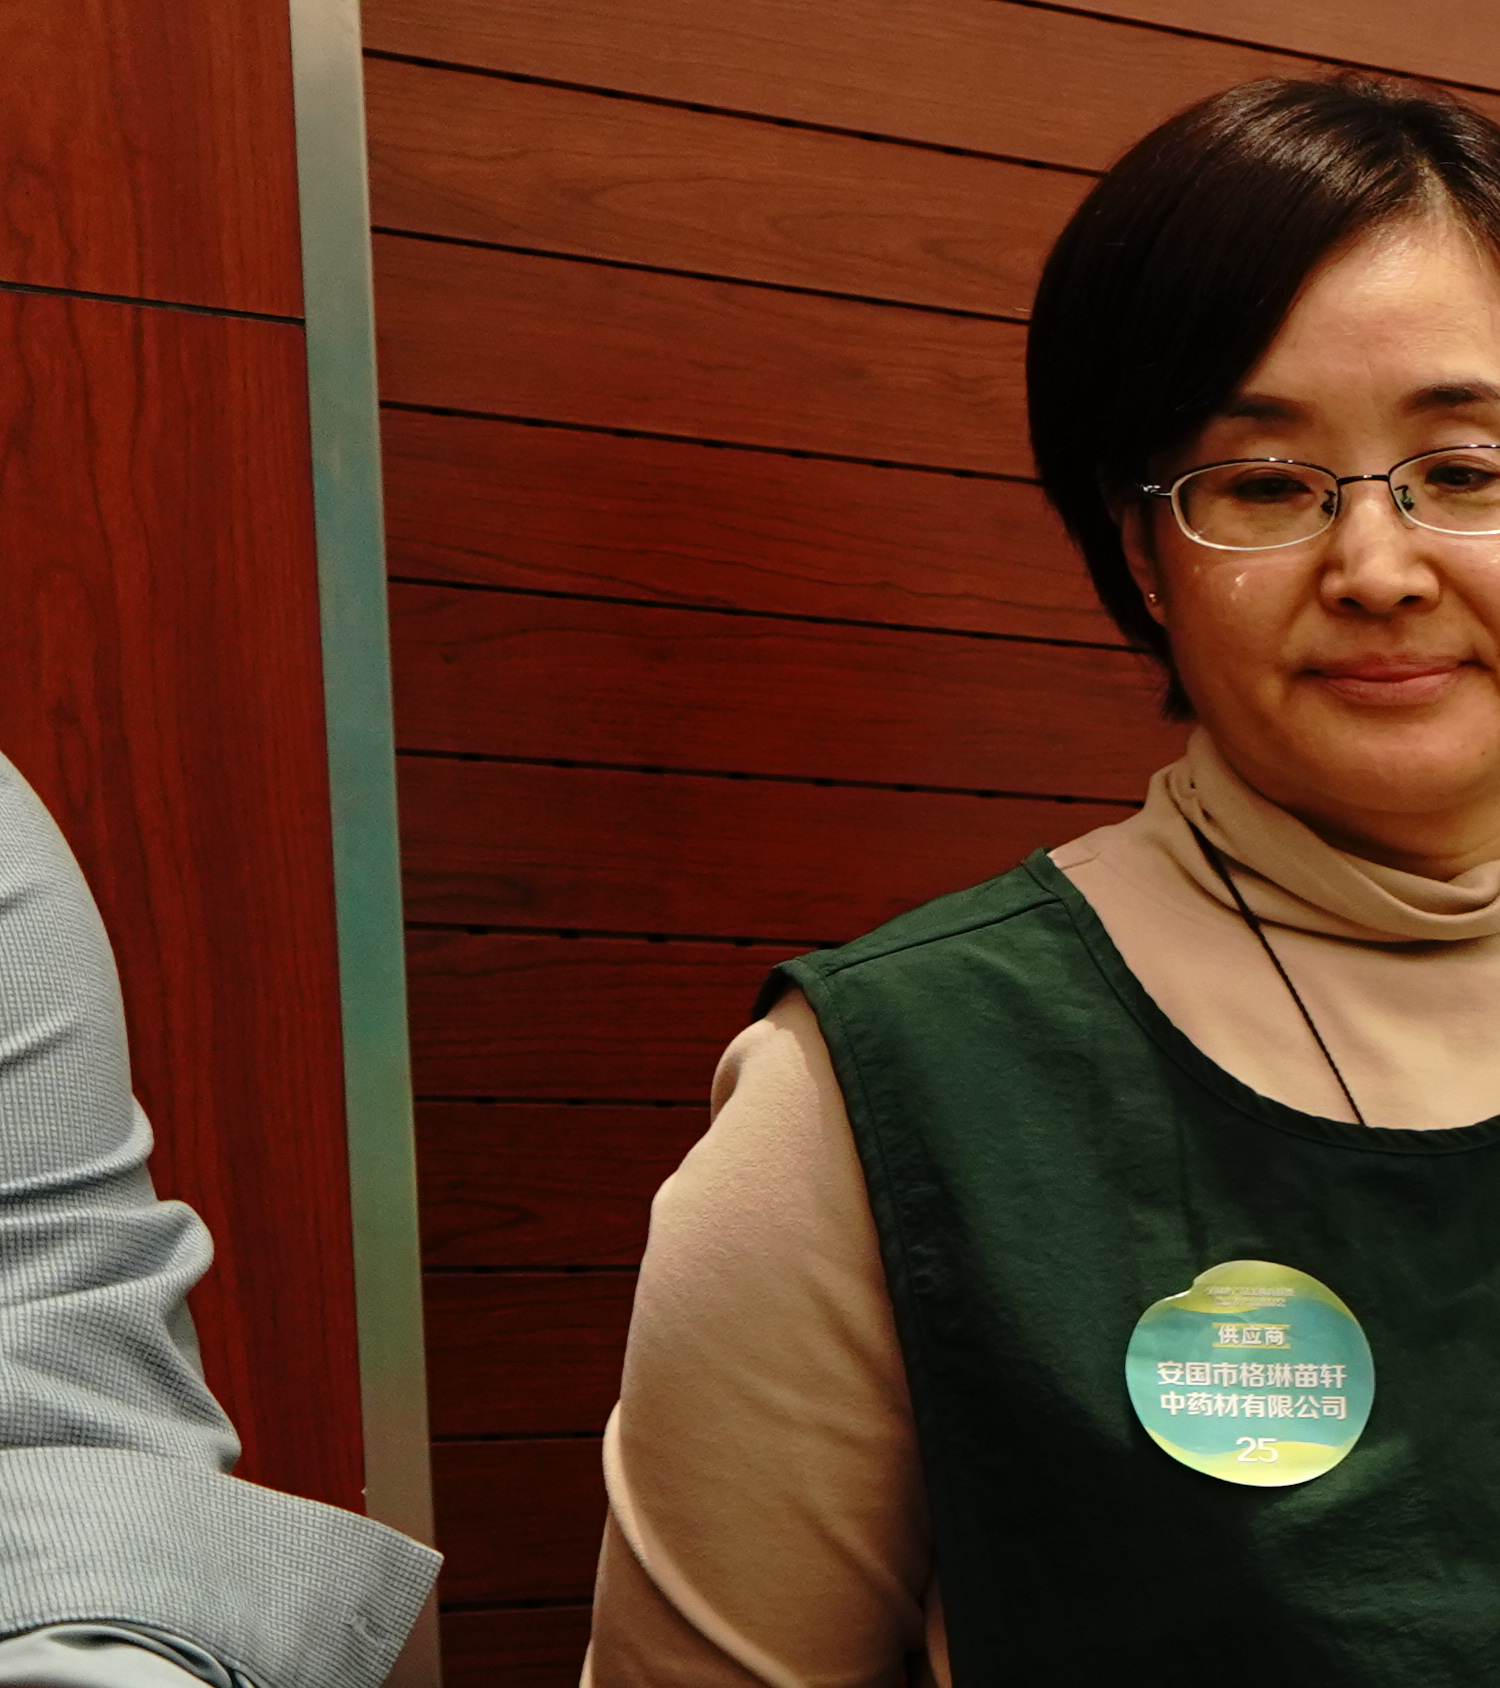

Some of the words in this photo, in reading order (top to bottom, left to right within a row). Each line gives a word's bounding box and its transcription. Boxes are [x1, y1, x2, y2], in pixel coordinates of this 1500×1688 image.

[1218, 1325, 1285, 1346] 供应商
[1157, 1360, 1347, 1389] 安国市格琳苗轩
[1160, 1390, 1347, 1420] 中药材有限公司
[1235, 1436, 1279, 1463] 25
